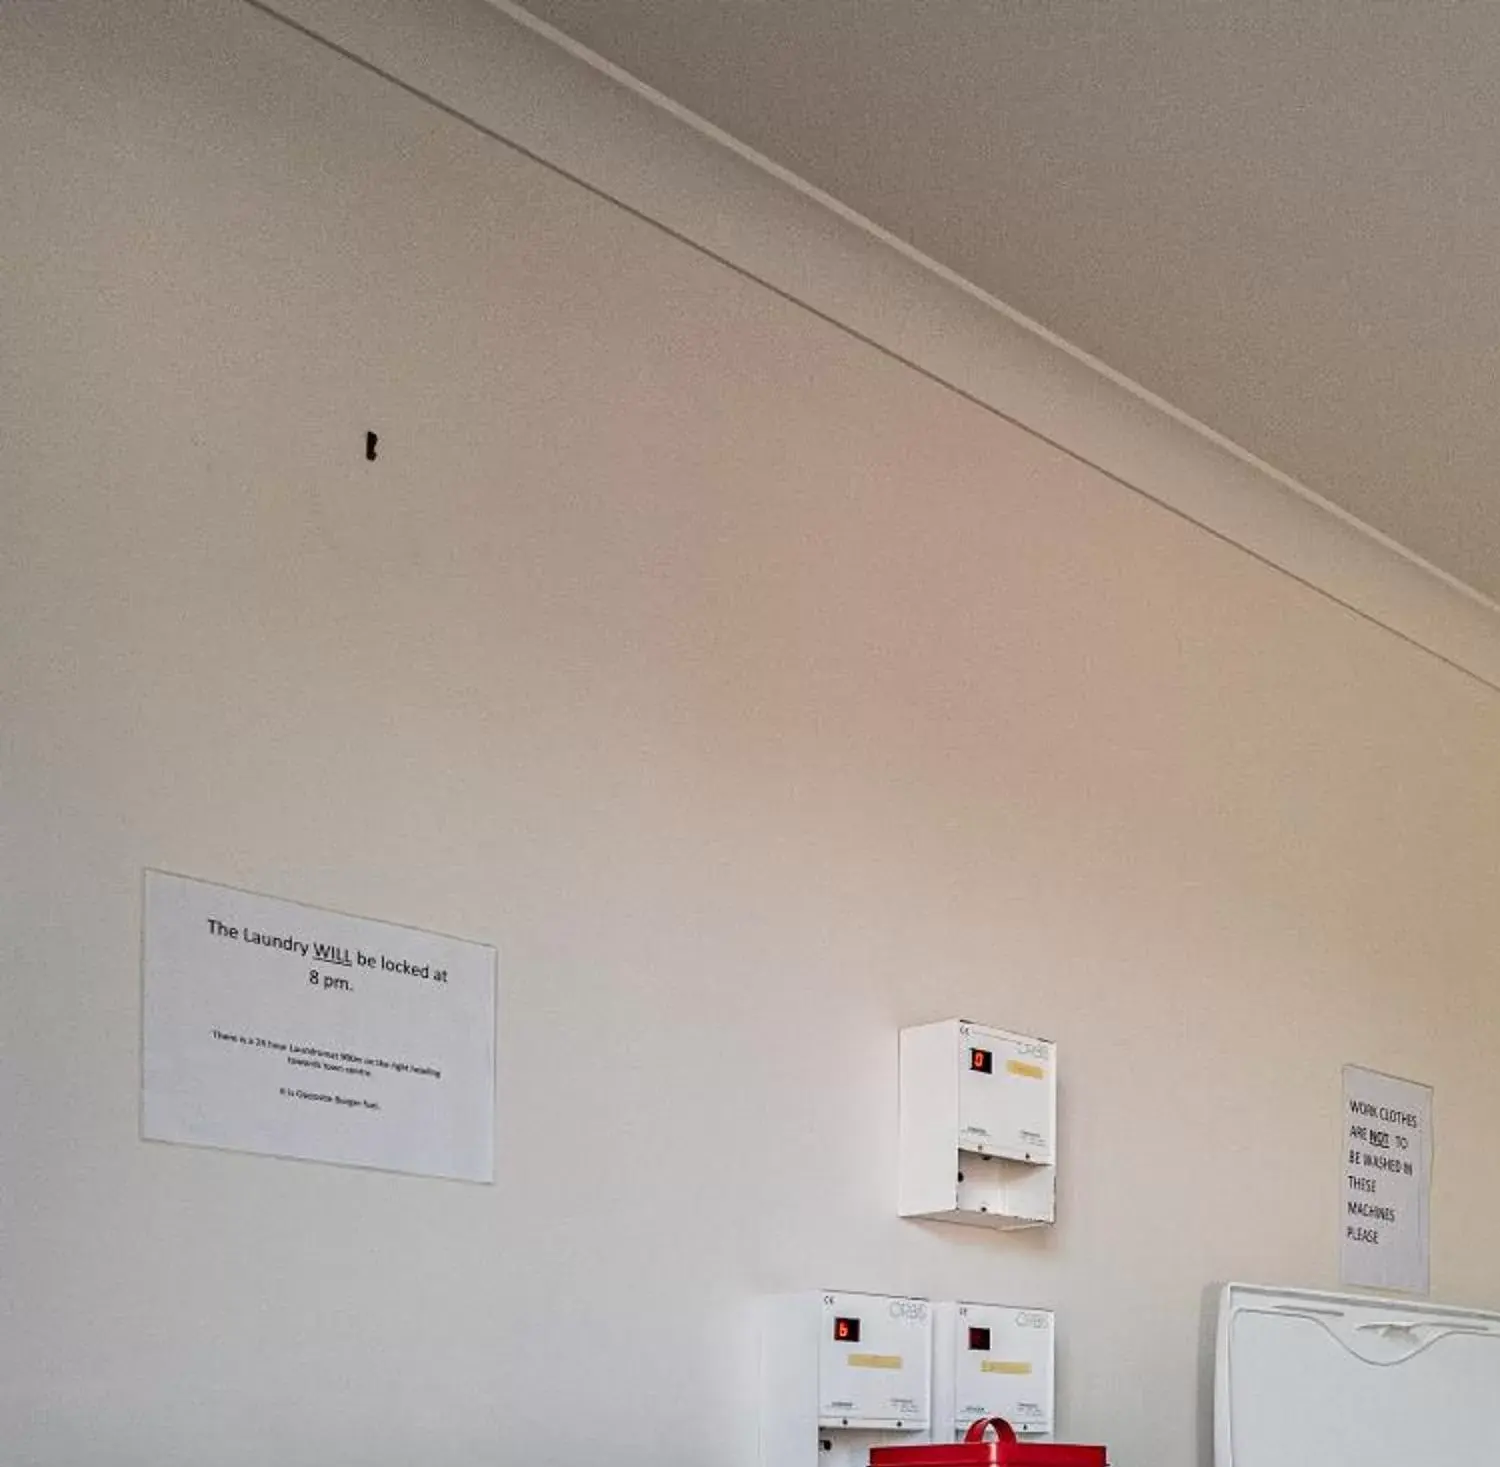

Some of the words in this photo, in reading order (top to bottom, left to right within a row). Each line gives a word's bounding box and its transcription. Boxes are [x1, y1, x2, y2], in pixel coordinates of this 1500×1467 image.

[208, 918, 239, 940] The
[244, 927, 309, 957] Laundry
[312, 942, 353, 966] WILL
[357, 951, 377, 968] be
[381, 955, 430, 979] locked
[433, 969, 448, 983] at
[309, 968, 319, 985] 8
[323, 973, 353, 991] pm.
[1350, 1099, 1378, 1118] WORK
[1380, 1106, 1417, 1129] CLOTHES
[1350, 1125, 1367, 1141] ARE
[1369, 1129, 1390, 1148] NOT
[1395, 1135, 1408, 1150] TO
[1349, 1149, 1360, 1165] BE
[1363, 1153, 1400, 1174] WASHED
[1403, 1161, 1413, 1176] IN
[1348, 1175, 1376, 1193] THESE
[1347, 1201, 1395, 1222] MACHINES
[1347, 1225, 1380, 1245] PLEASE
